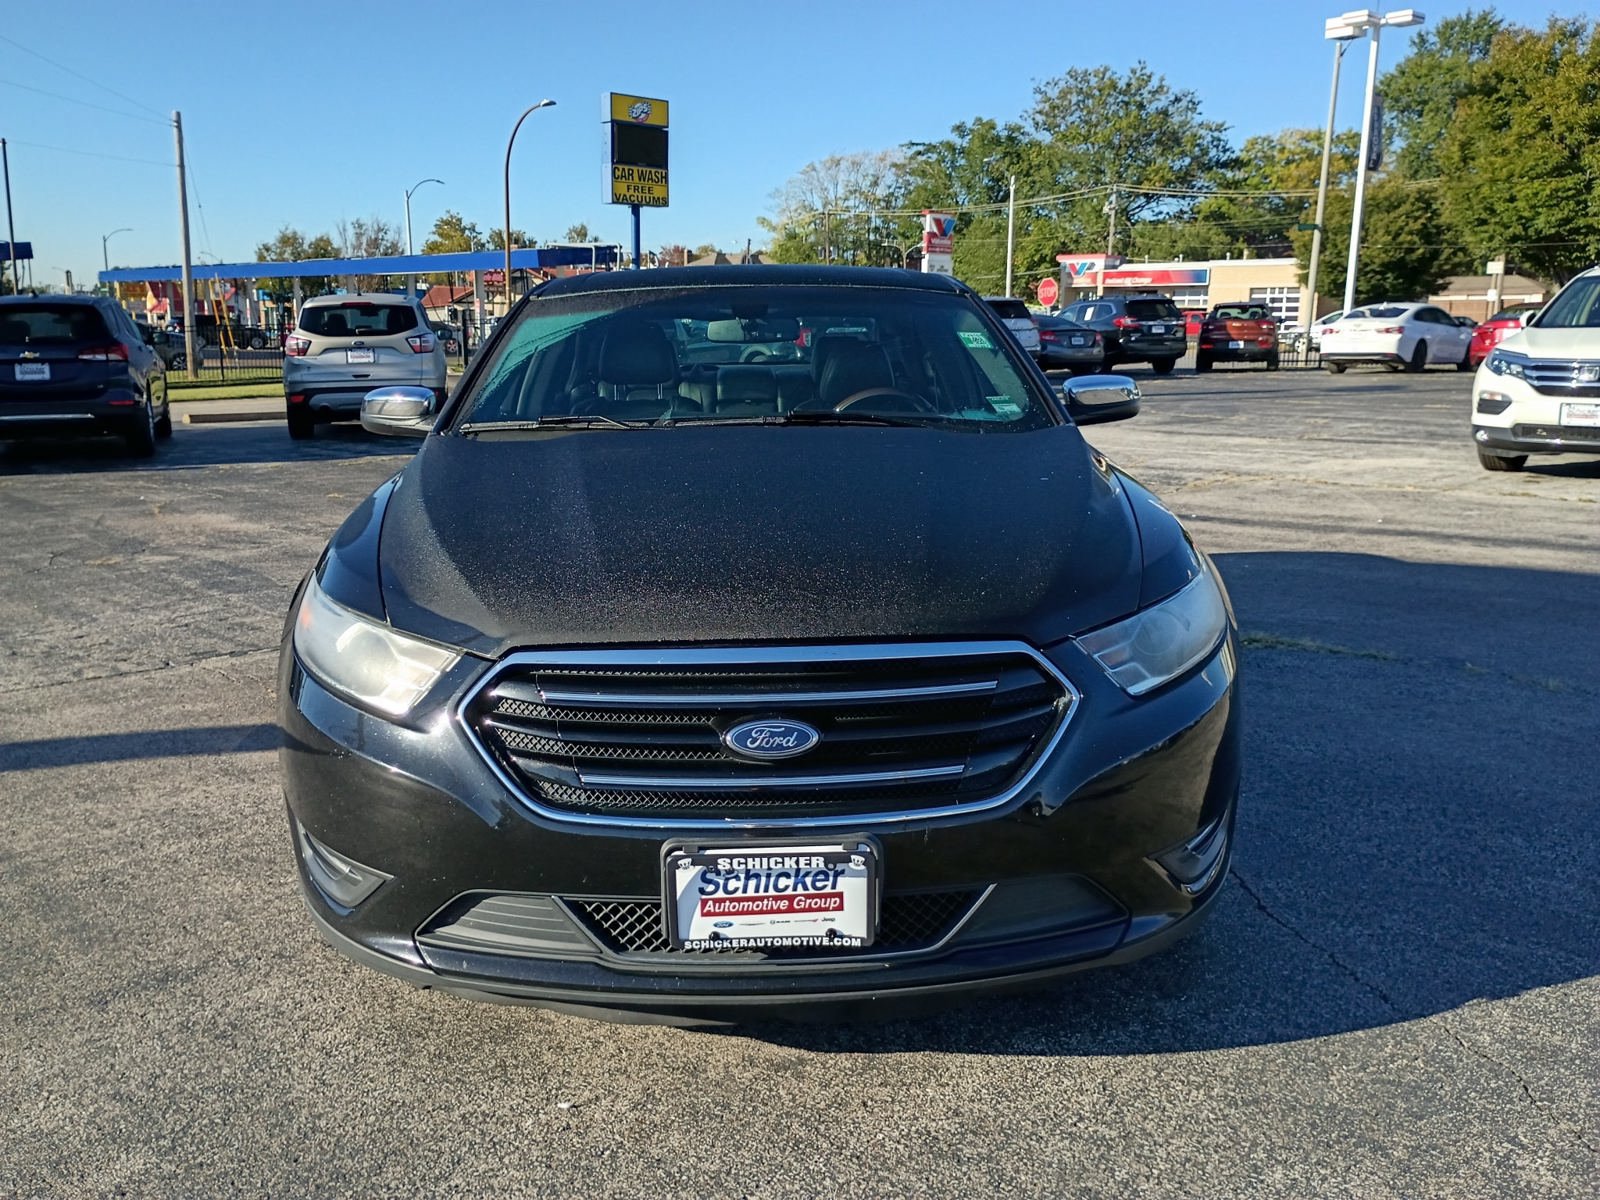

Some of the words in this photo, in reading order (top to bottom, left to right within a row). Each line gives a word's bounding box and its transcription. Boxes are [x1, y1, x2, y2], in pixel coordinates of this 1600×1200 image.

[613, 166, 635, 181] CAR
[637, 168, 668, 184] WASH
[626, 184, 654, 195] FREE
[614, 192, 668, 206] VACUUMS
[1038, 286, 1057, 299] STOP
[746, 727, 798, 749] Ford
[716, 856, 825, 870] SCHICKER
[698, 866, 845, 896] Schicker
[703, 897, 788, 914] Automotive
[793, 896, 840, 912] Group
[684, 936, 862, 950] SCHICKERAUTOMOTIVE.COM
